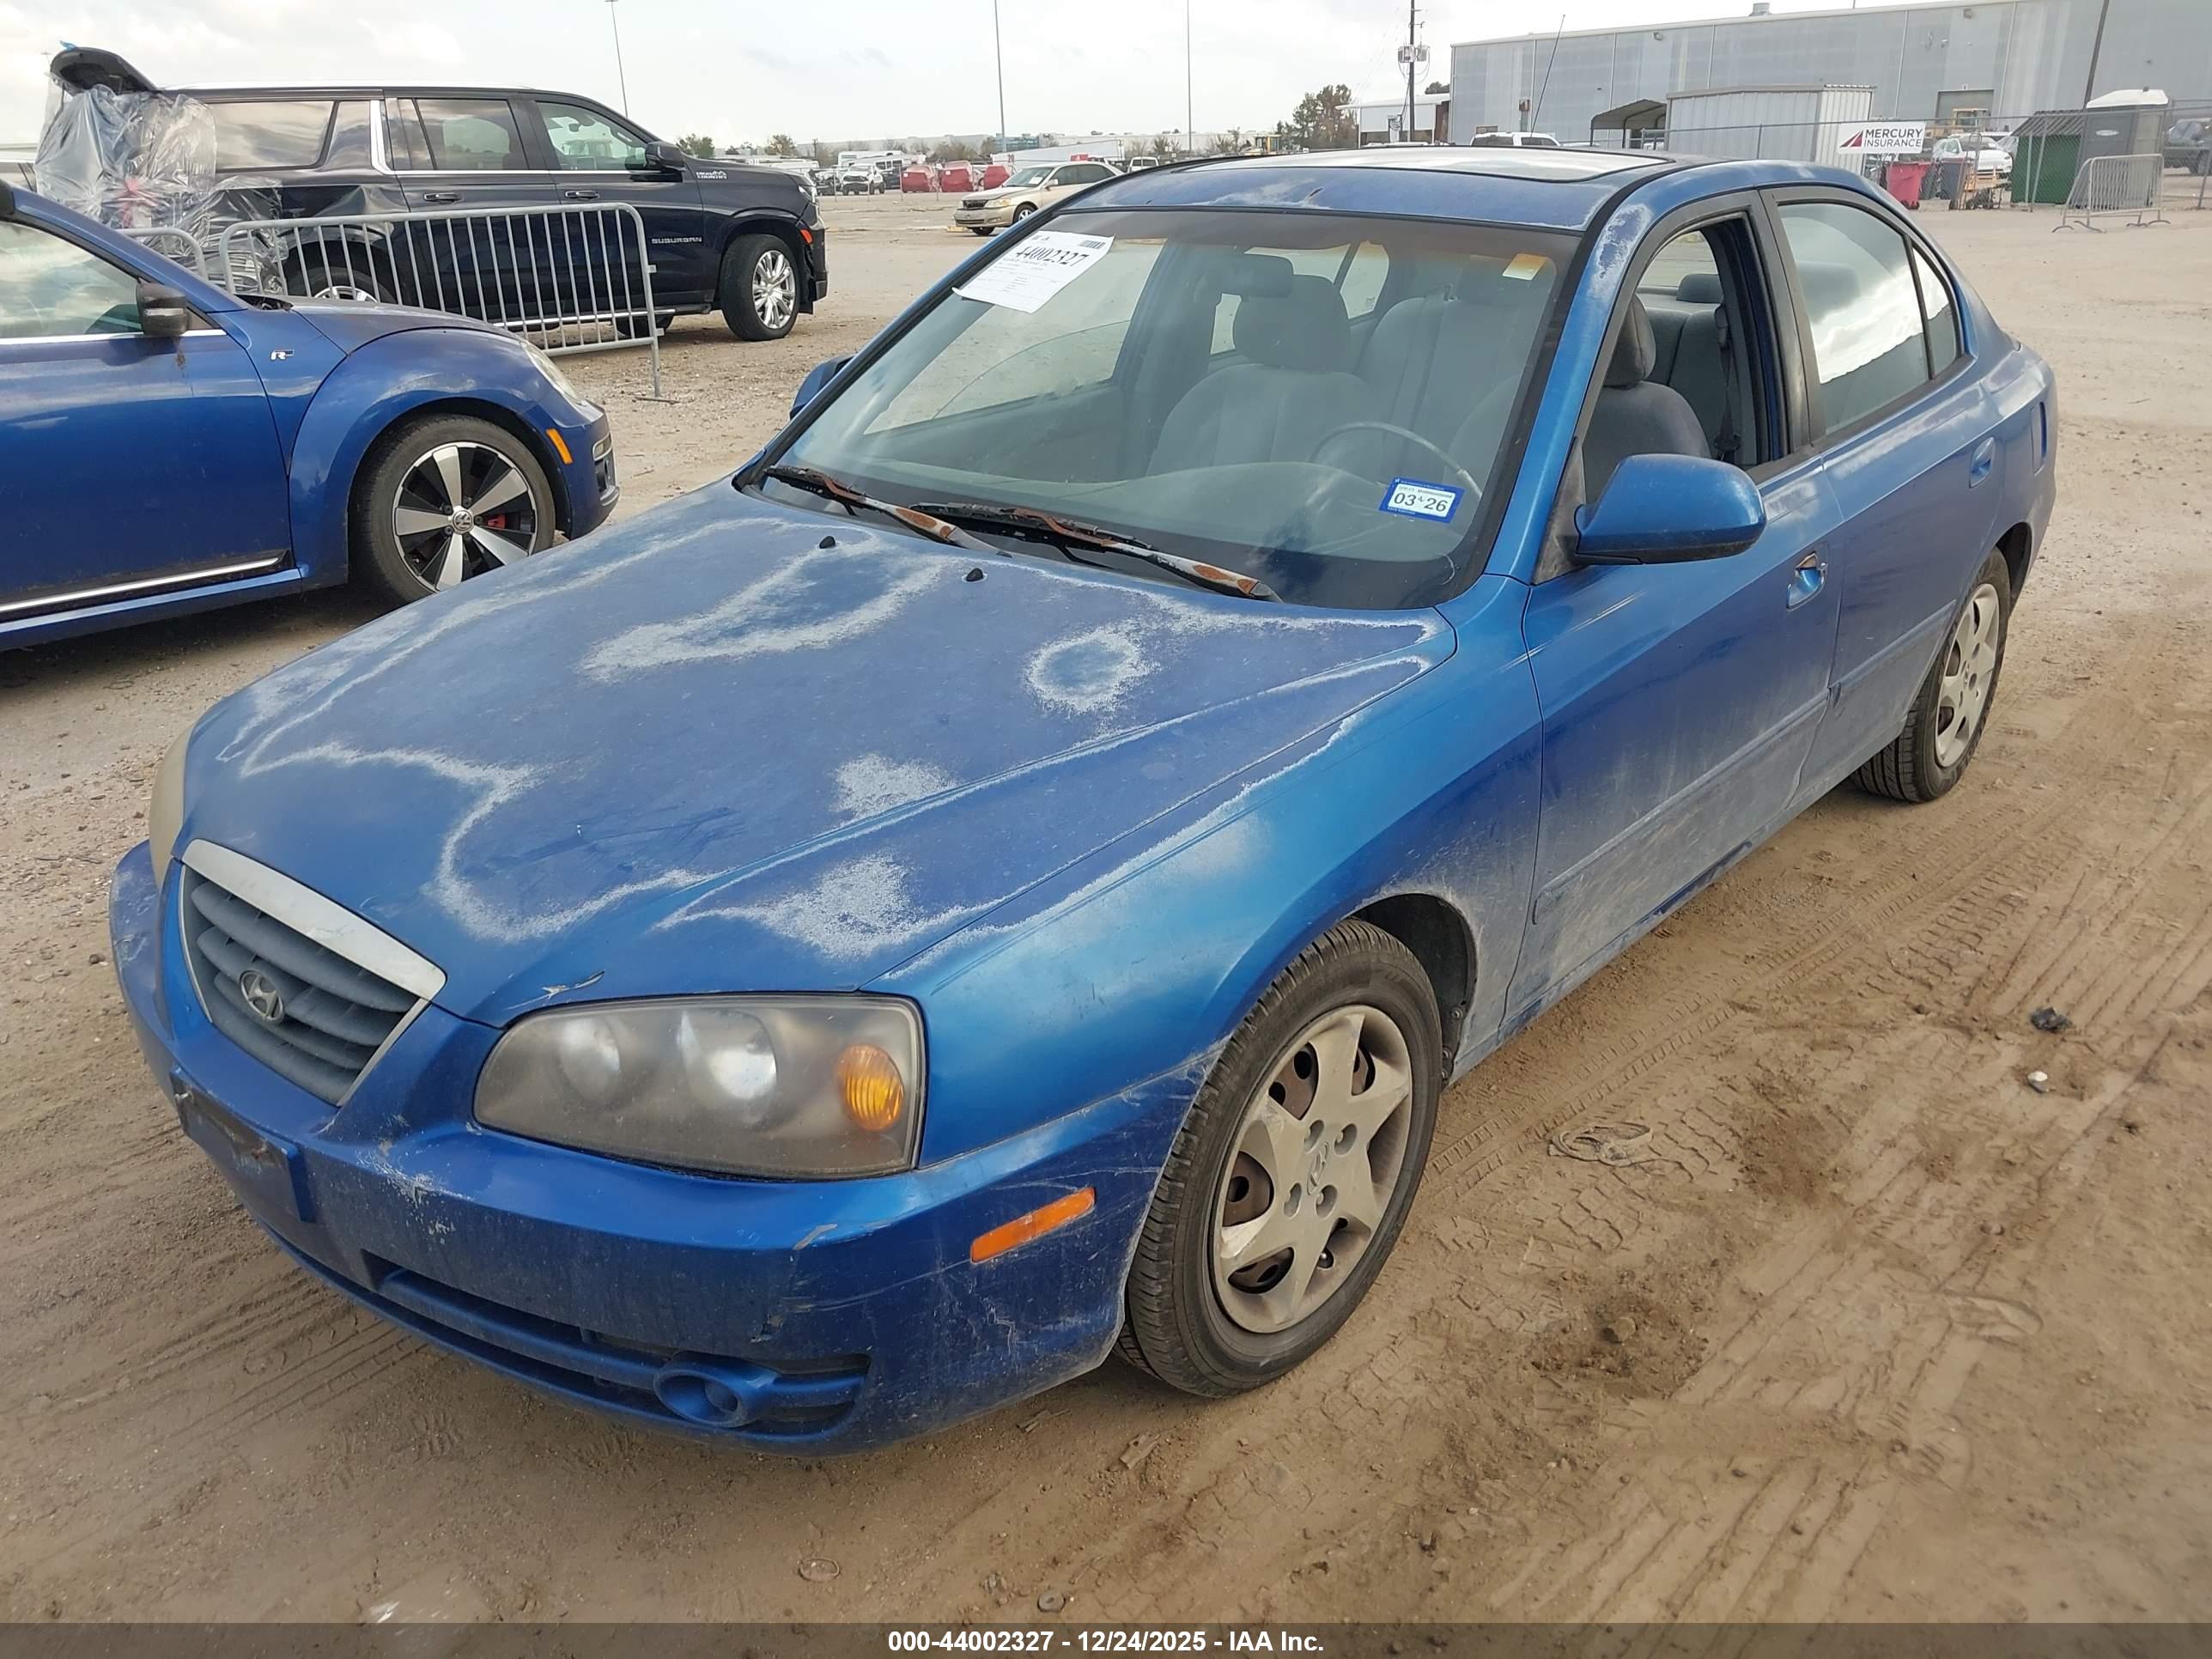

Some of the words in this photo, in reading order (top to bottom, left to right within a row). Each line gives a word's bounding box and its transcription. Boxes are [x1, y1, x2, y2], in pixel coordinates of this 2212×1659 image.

[1865, 129, 1923, 137] MERCURY
[1864, 138, 1922, 148] INSURANCE
[1015, 246, 1090, 267] 44002327
[1394, 493, 1417, 507] 03
[1424, 497, 1448, 513] 26
